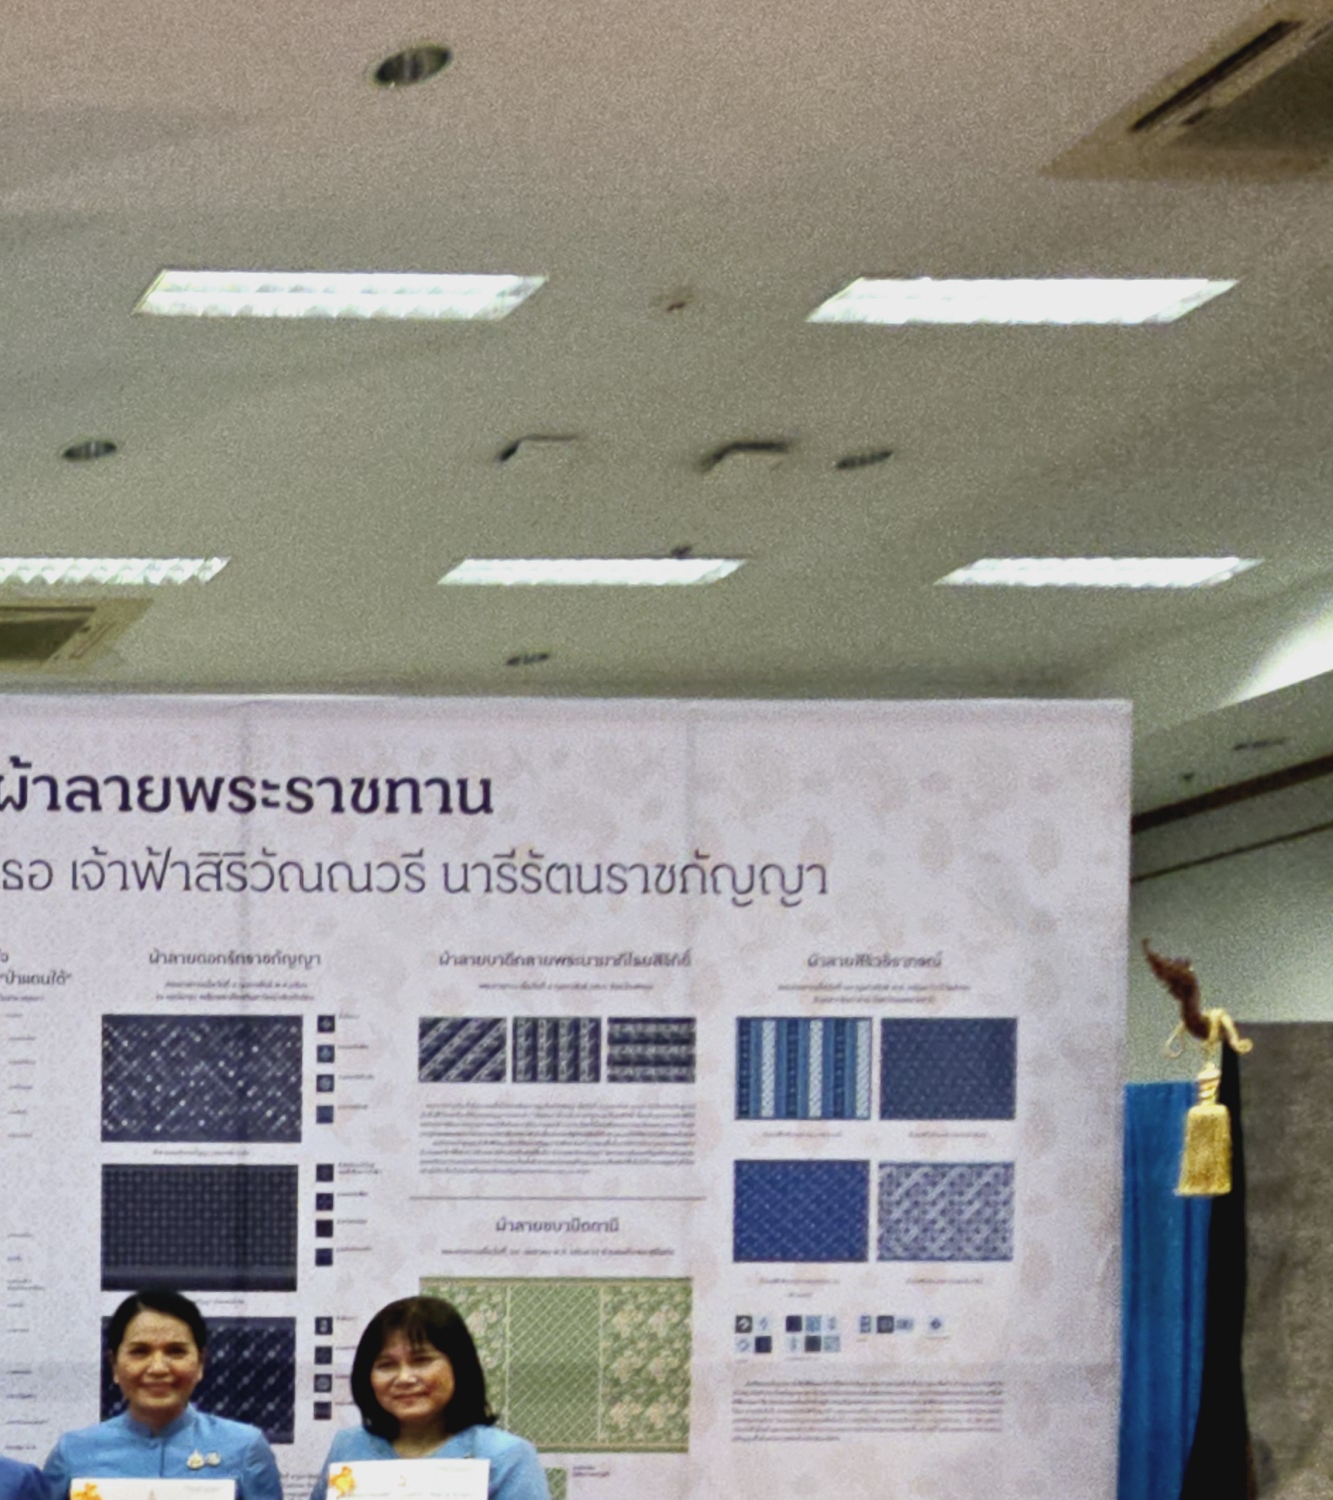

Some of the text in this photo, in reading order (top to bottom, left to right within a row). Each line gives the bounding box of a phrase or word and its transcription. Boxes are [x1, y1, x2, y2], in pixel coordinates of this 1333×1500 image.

[72, 847, 425, 895] เจ้าฟ้าสิริวัณณวรี
[443, 849, 827, 907] นารีรัตนราชกัญญา
